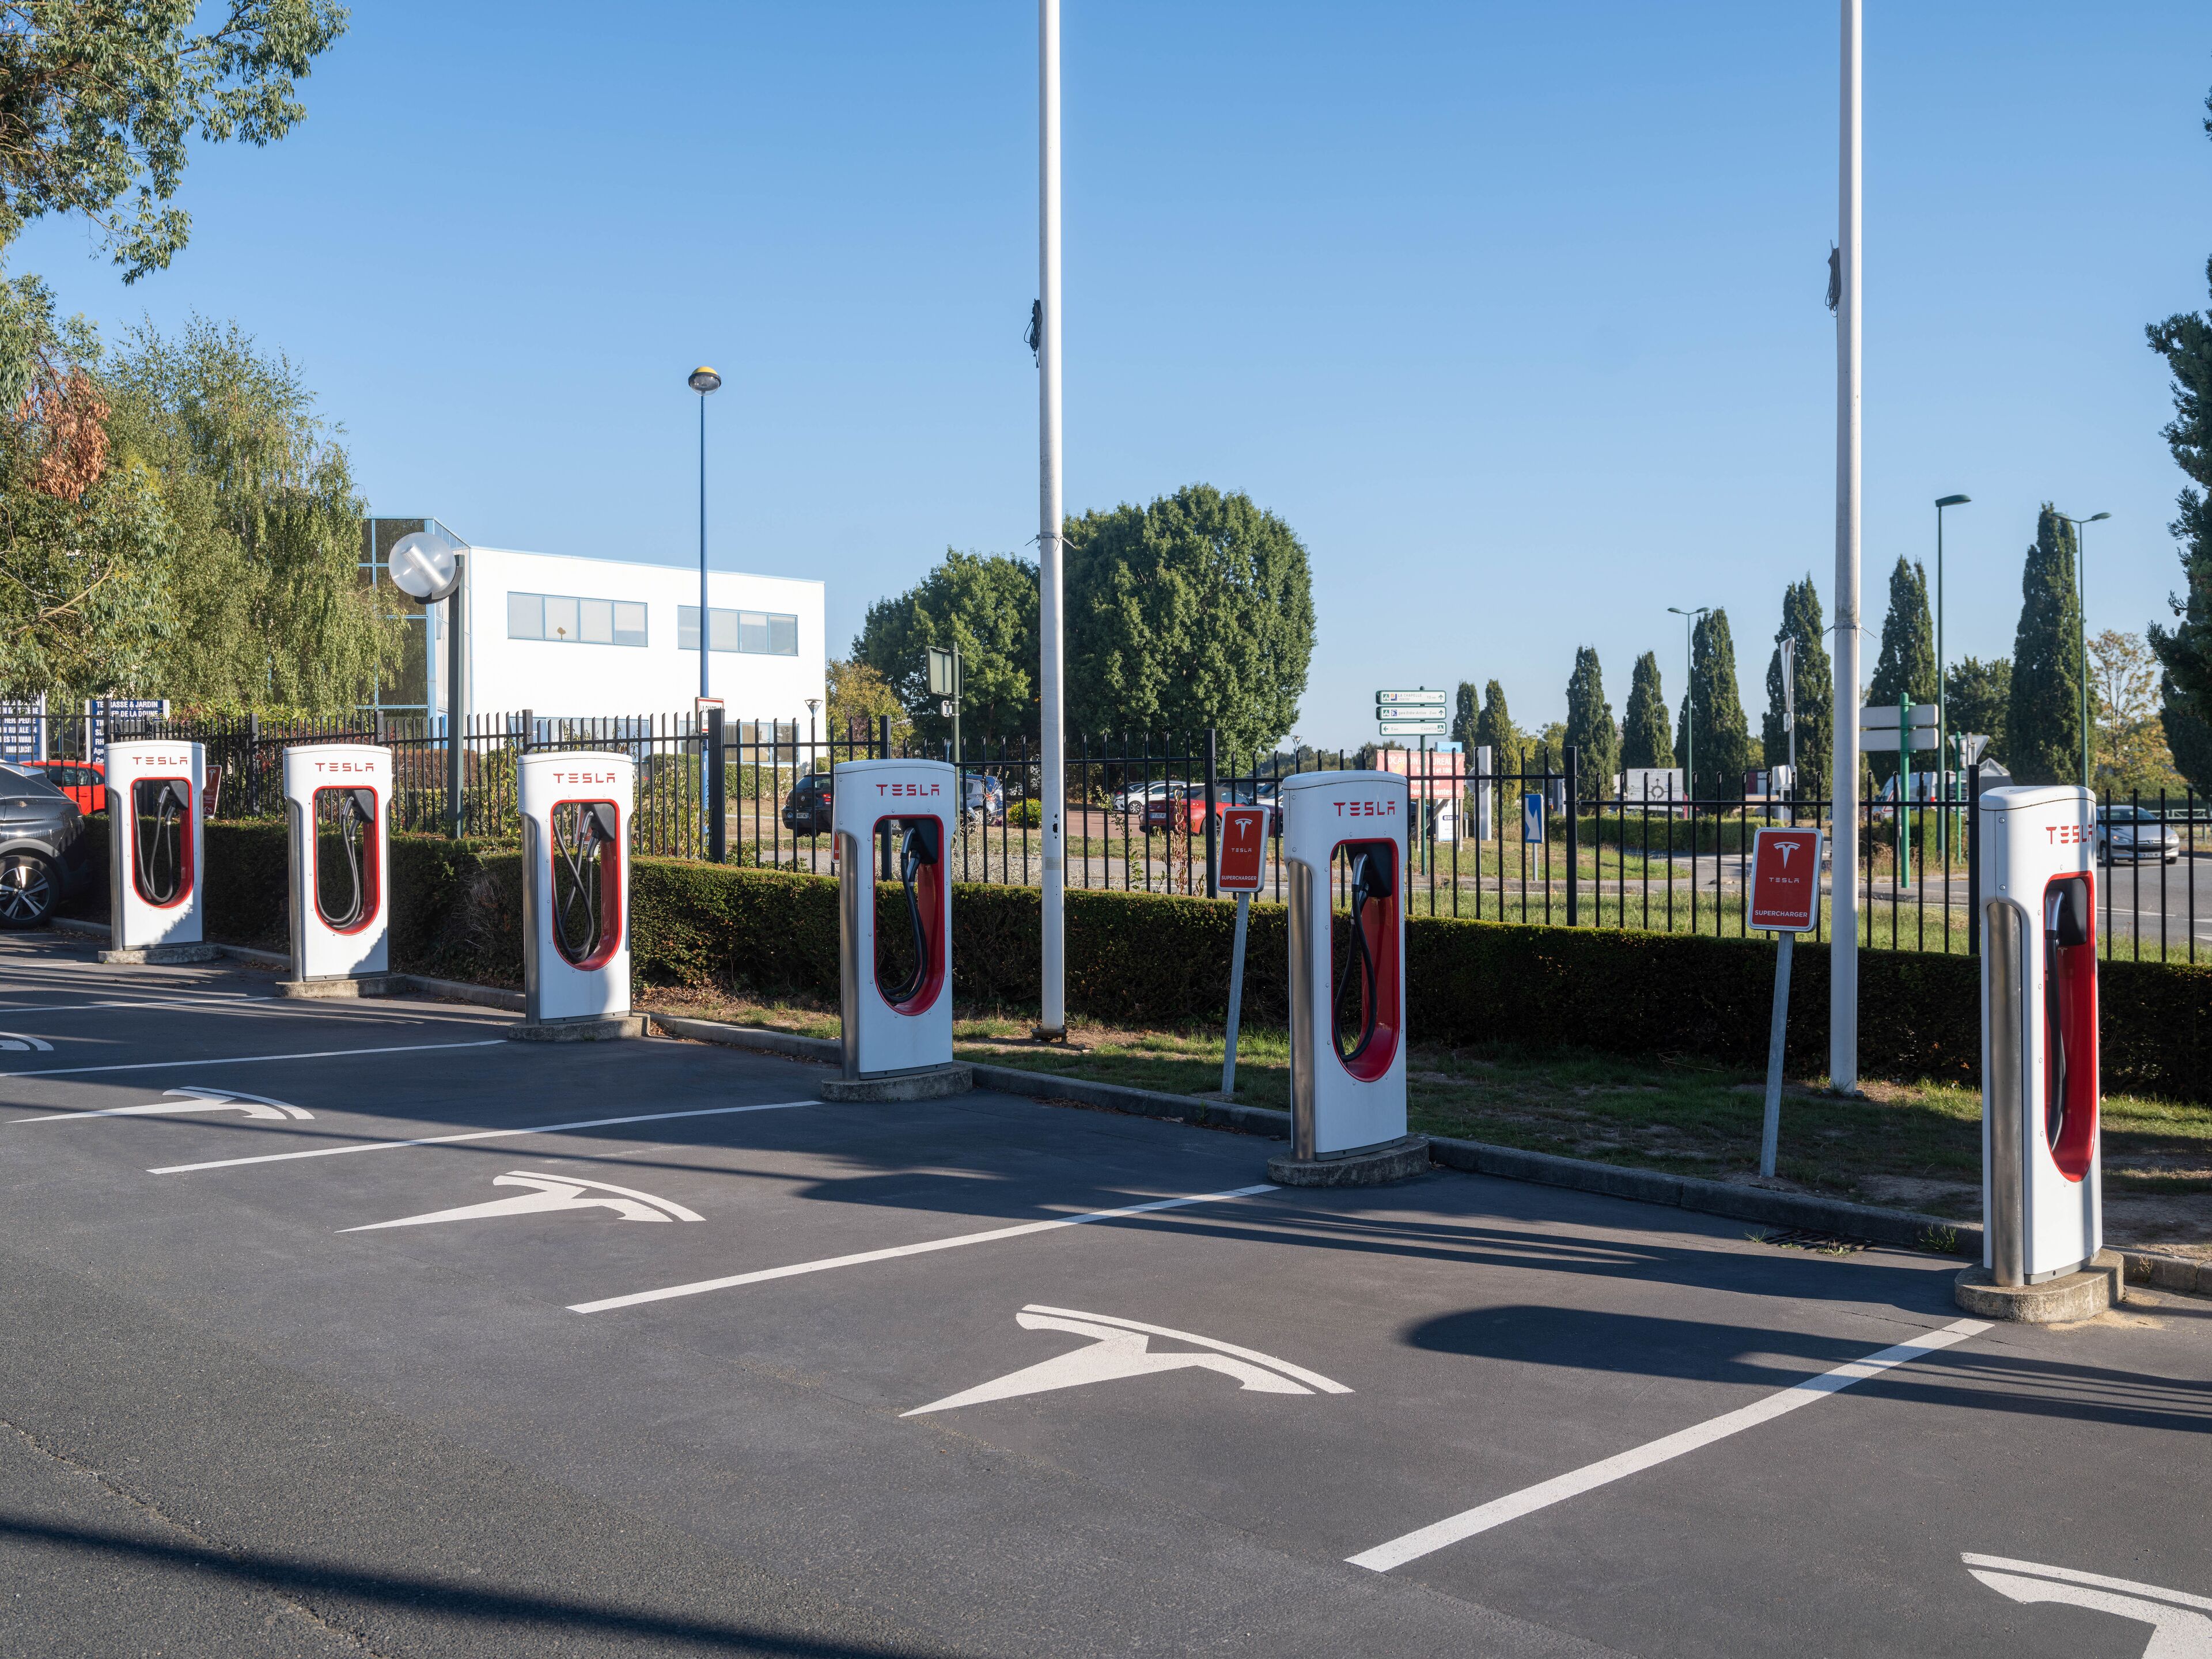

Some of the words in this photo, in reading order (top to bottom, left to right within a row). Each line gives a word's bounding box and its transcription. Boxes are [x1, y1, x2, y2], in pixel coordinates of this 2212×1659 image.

[132, 756, 188, 765] TESLA
[315, 762, 373, 772] TESLA
[553, 773, 616, 783] TESLA
[876, 784, 940, 796] TESLA
[1334, 801, 1395, 816] TESLA
[2046, 824, 2093, 844] TESLA
